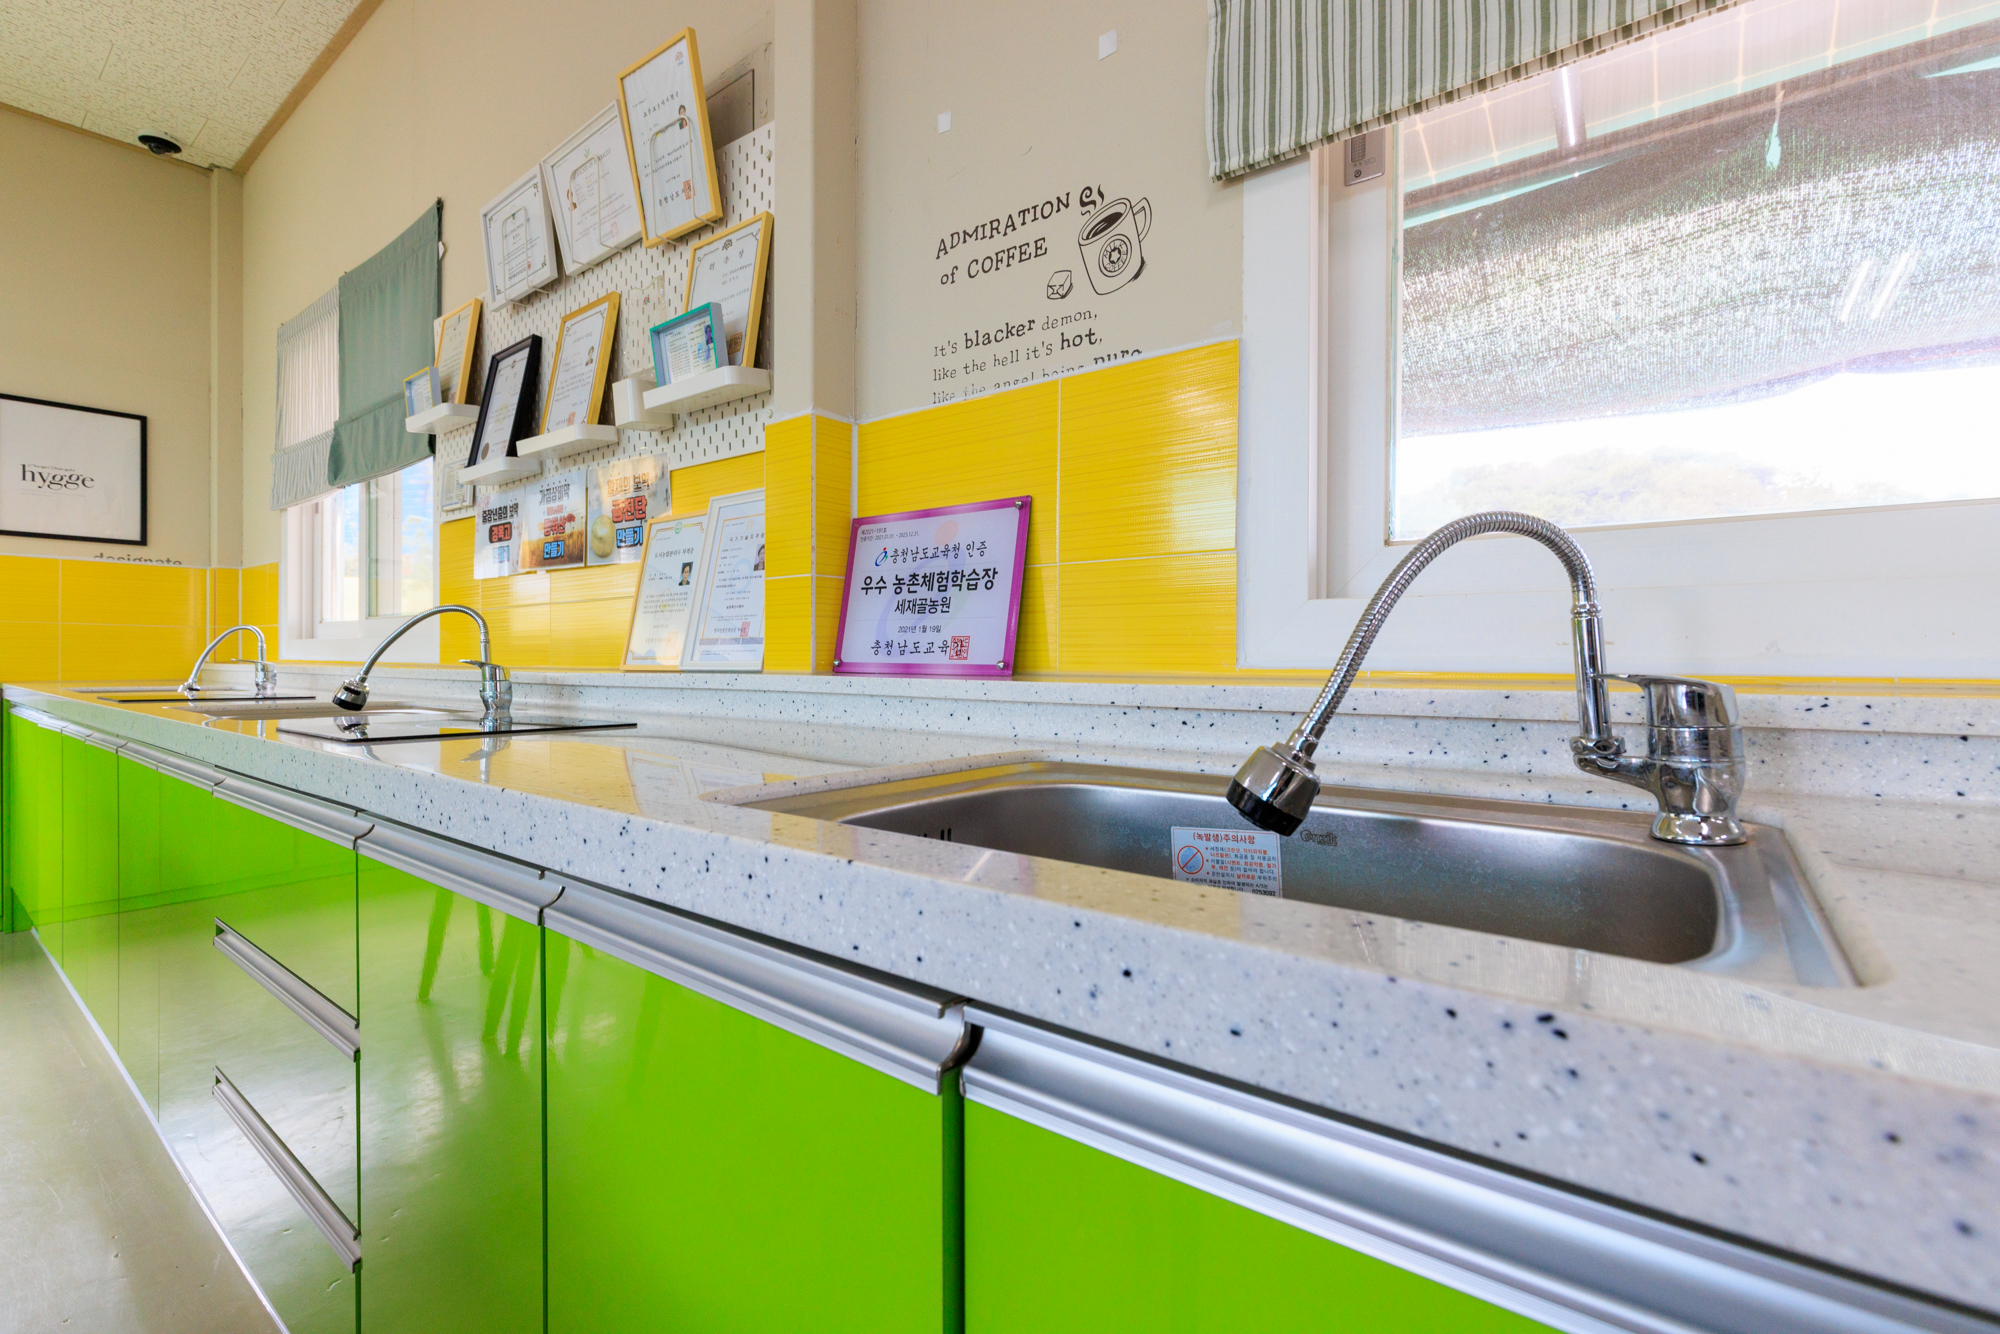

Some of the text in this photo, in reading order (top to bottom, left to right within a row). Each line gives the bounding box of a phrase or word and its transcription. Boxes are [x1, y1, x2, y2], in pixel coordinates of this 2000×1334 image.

[935, 192, 1071, 259] ADMIRATION
[940, 237, 1048, 285] of COFFEE
[1103, 241, 1125, 259] MILK
[934, 309, 1098, 357] It's blacker demon,
[933, 328, 1103, 382] like the hell it's hot,
[932, 391, 956, 405] like
[20, 463, 95, 491] hygge
[633, 472, 650, 492] 보약
[539, 485, 570, 505] 가정상비약
[481, 502, 519, 524] 중장년층의 보약
[612, 495, 647, 523] 공진단
[491, 523, 511, 542] 경옥고
[616, 526, 643, 548] 만들기
[543, 540, 565, 560] 만들기
[890, 540, 988, 564] 충청남도교육청 인증
[861, 567, 999, 595] 우수 농촌체험학습장
[894, 596, 951, 615] 세재골농원
[918, 625, 928, 633] 1월
[929, 625, 942, 633] 19일
[1193, 832, 1255, 844] (녹발생)주의사항
